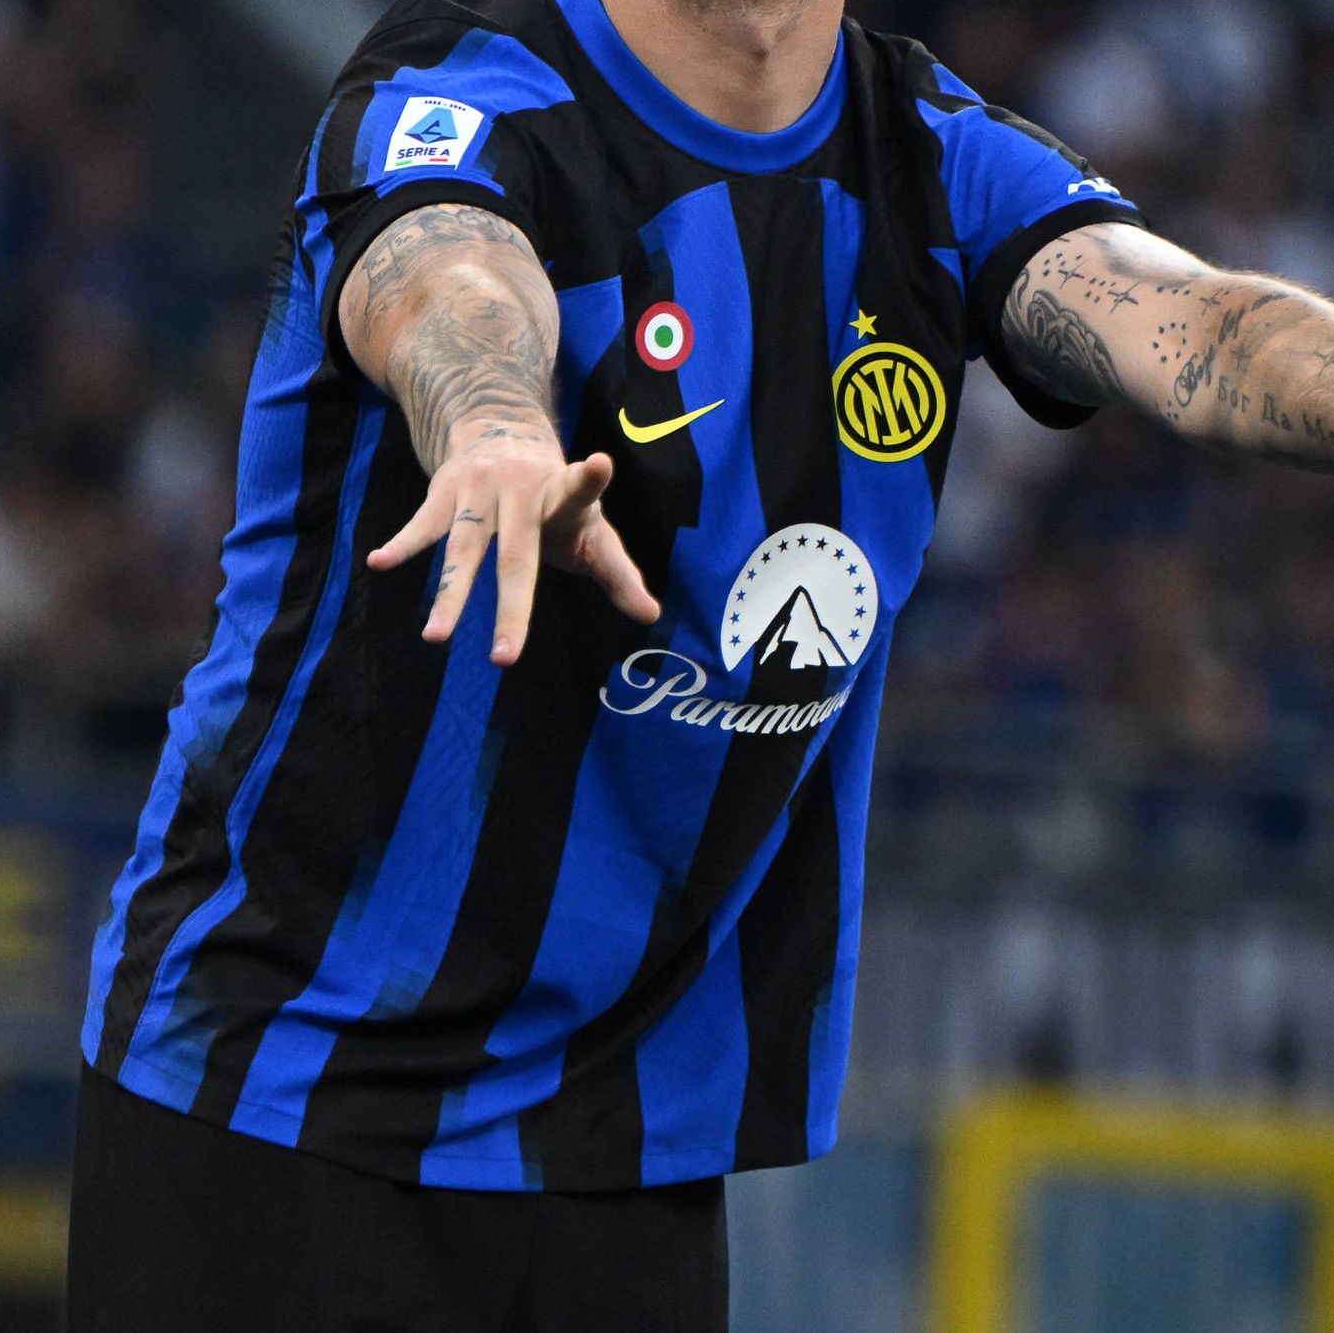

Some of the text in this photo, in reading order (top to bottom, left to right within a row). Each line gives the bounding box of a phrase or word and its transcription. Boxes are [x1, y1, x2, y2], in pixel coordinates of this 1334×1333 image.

[396, 147, 451, 159] SERIE A
[599, 649, 857, 735] Paramoun
